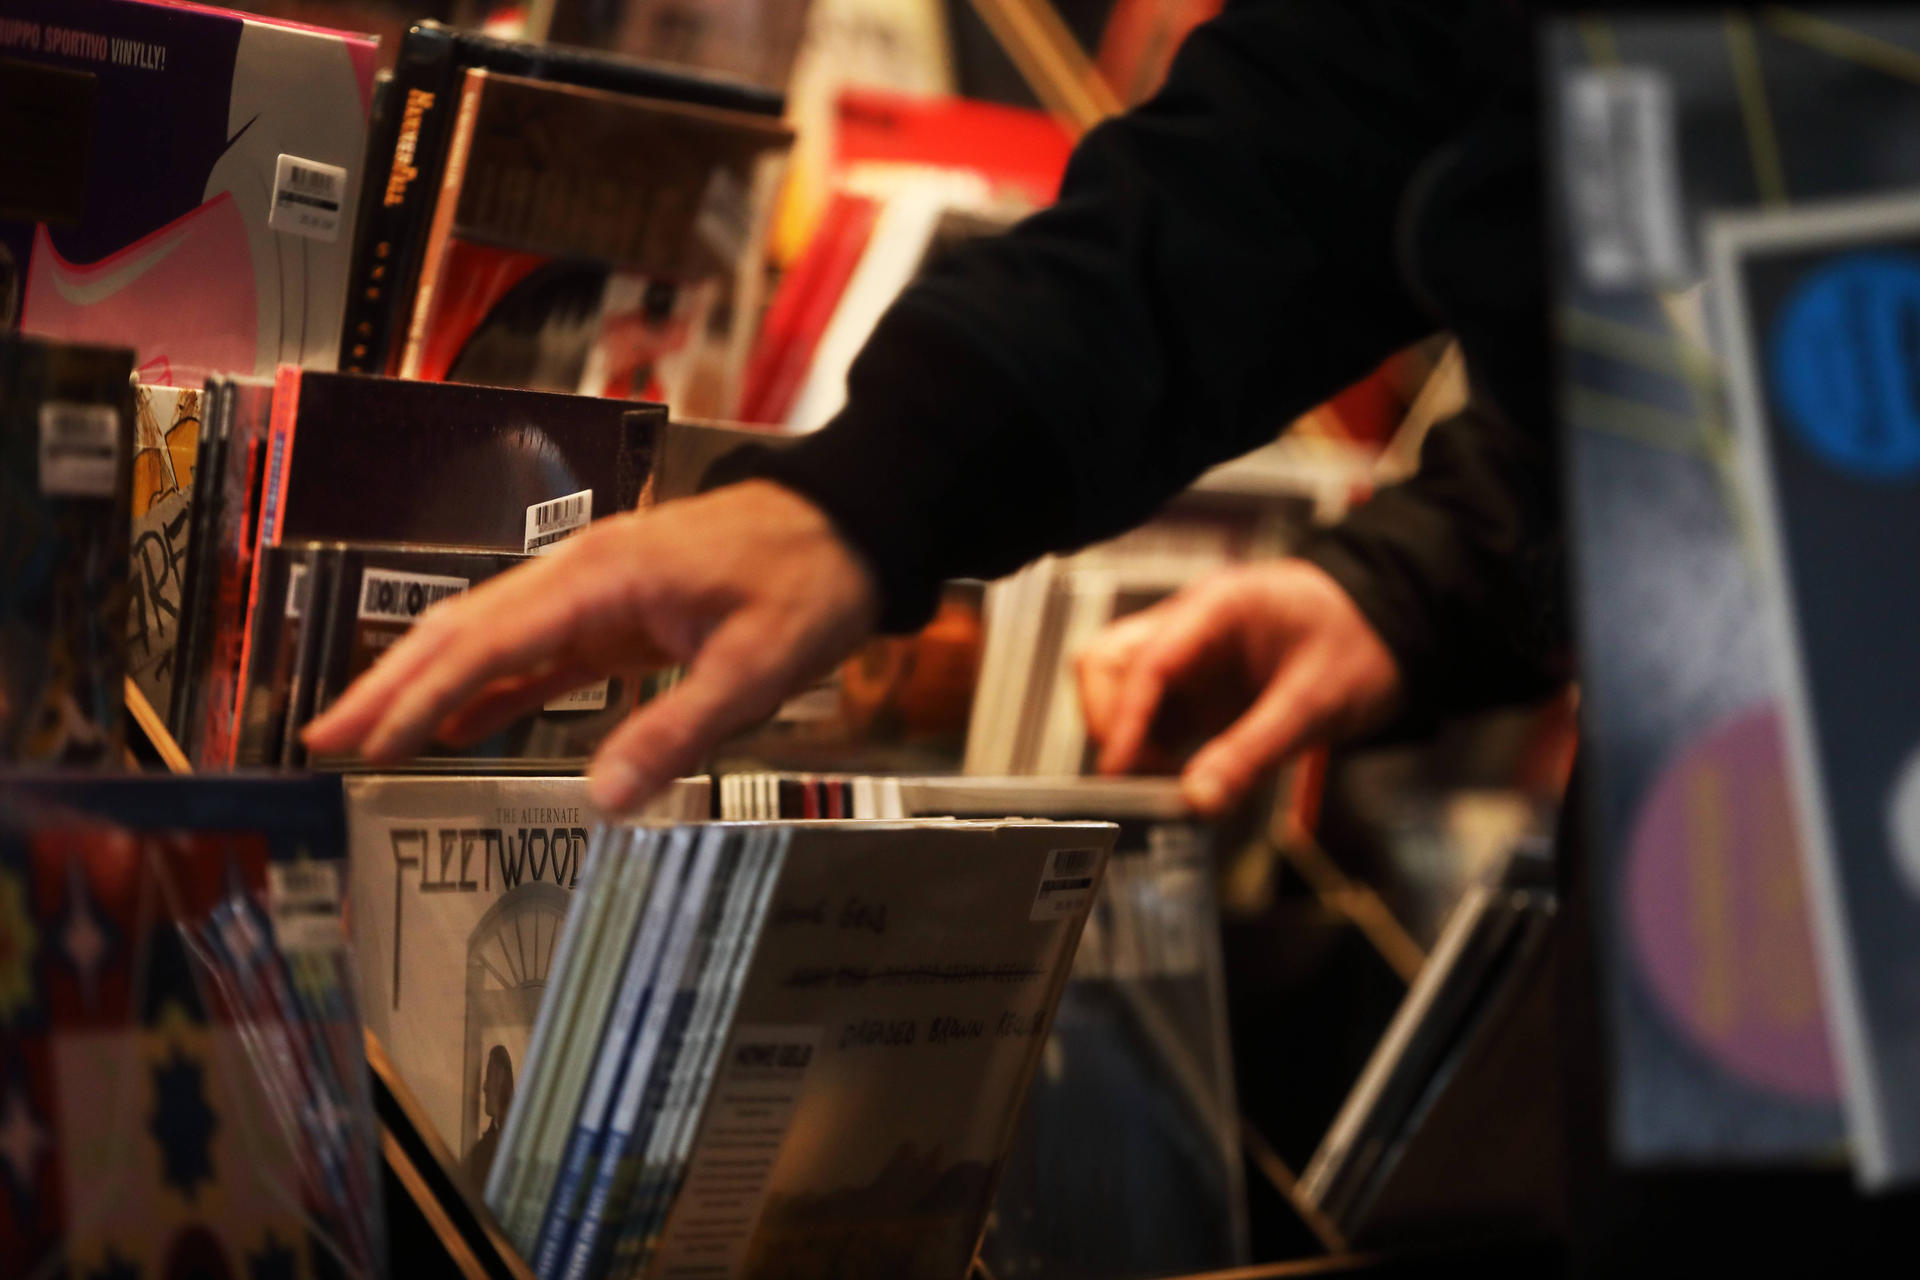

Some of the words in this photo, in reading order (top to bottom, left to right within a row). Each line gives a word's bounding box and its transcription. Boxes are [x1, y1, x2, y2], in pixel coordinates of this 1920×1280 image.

[43, 24, 107, 61] SPORTIVO
[111, 37, 166, 71] VINYLLY!
[497, 808, 517, 823] THE
[521, 807, 579, 824] ALTERNATE
